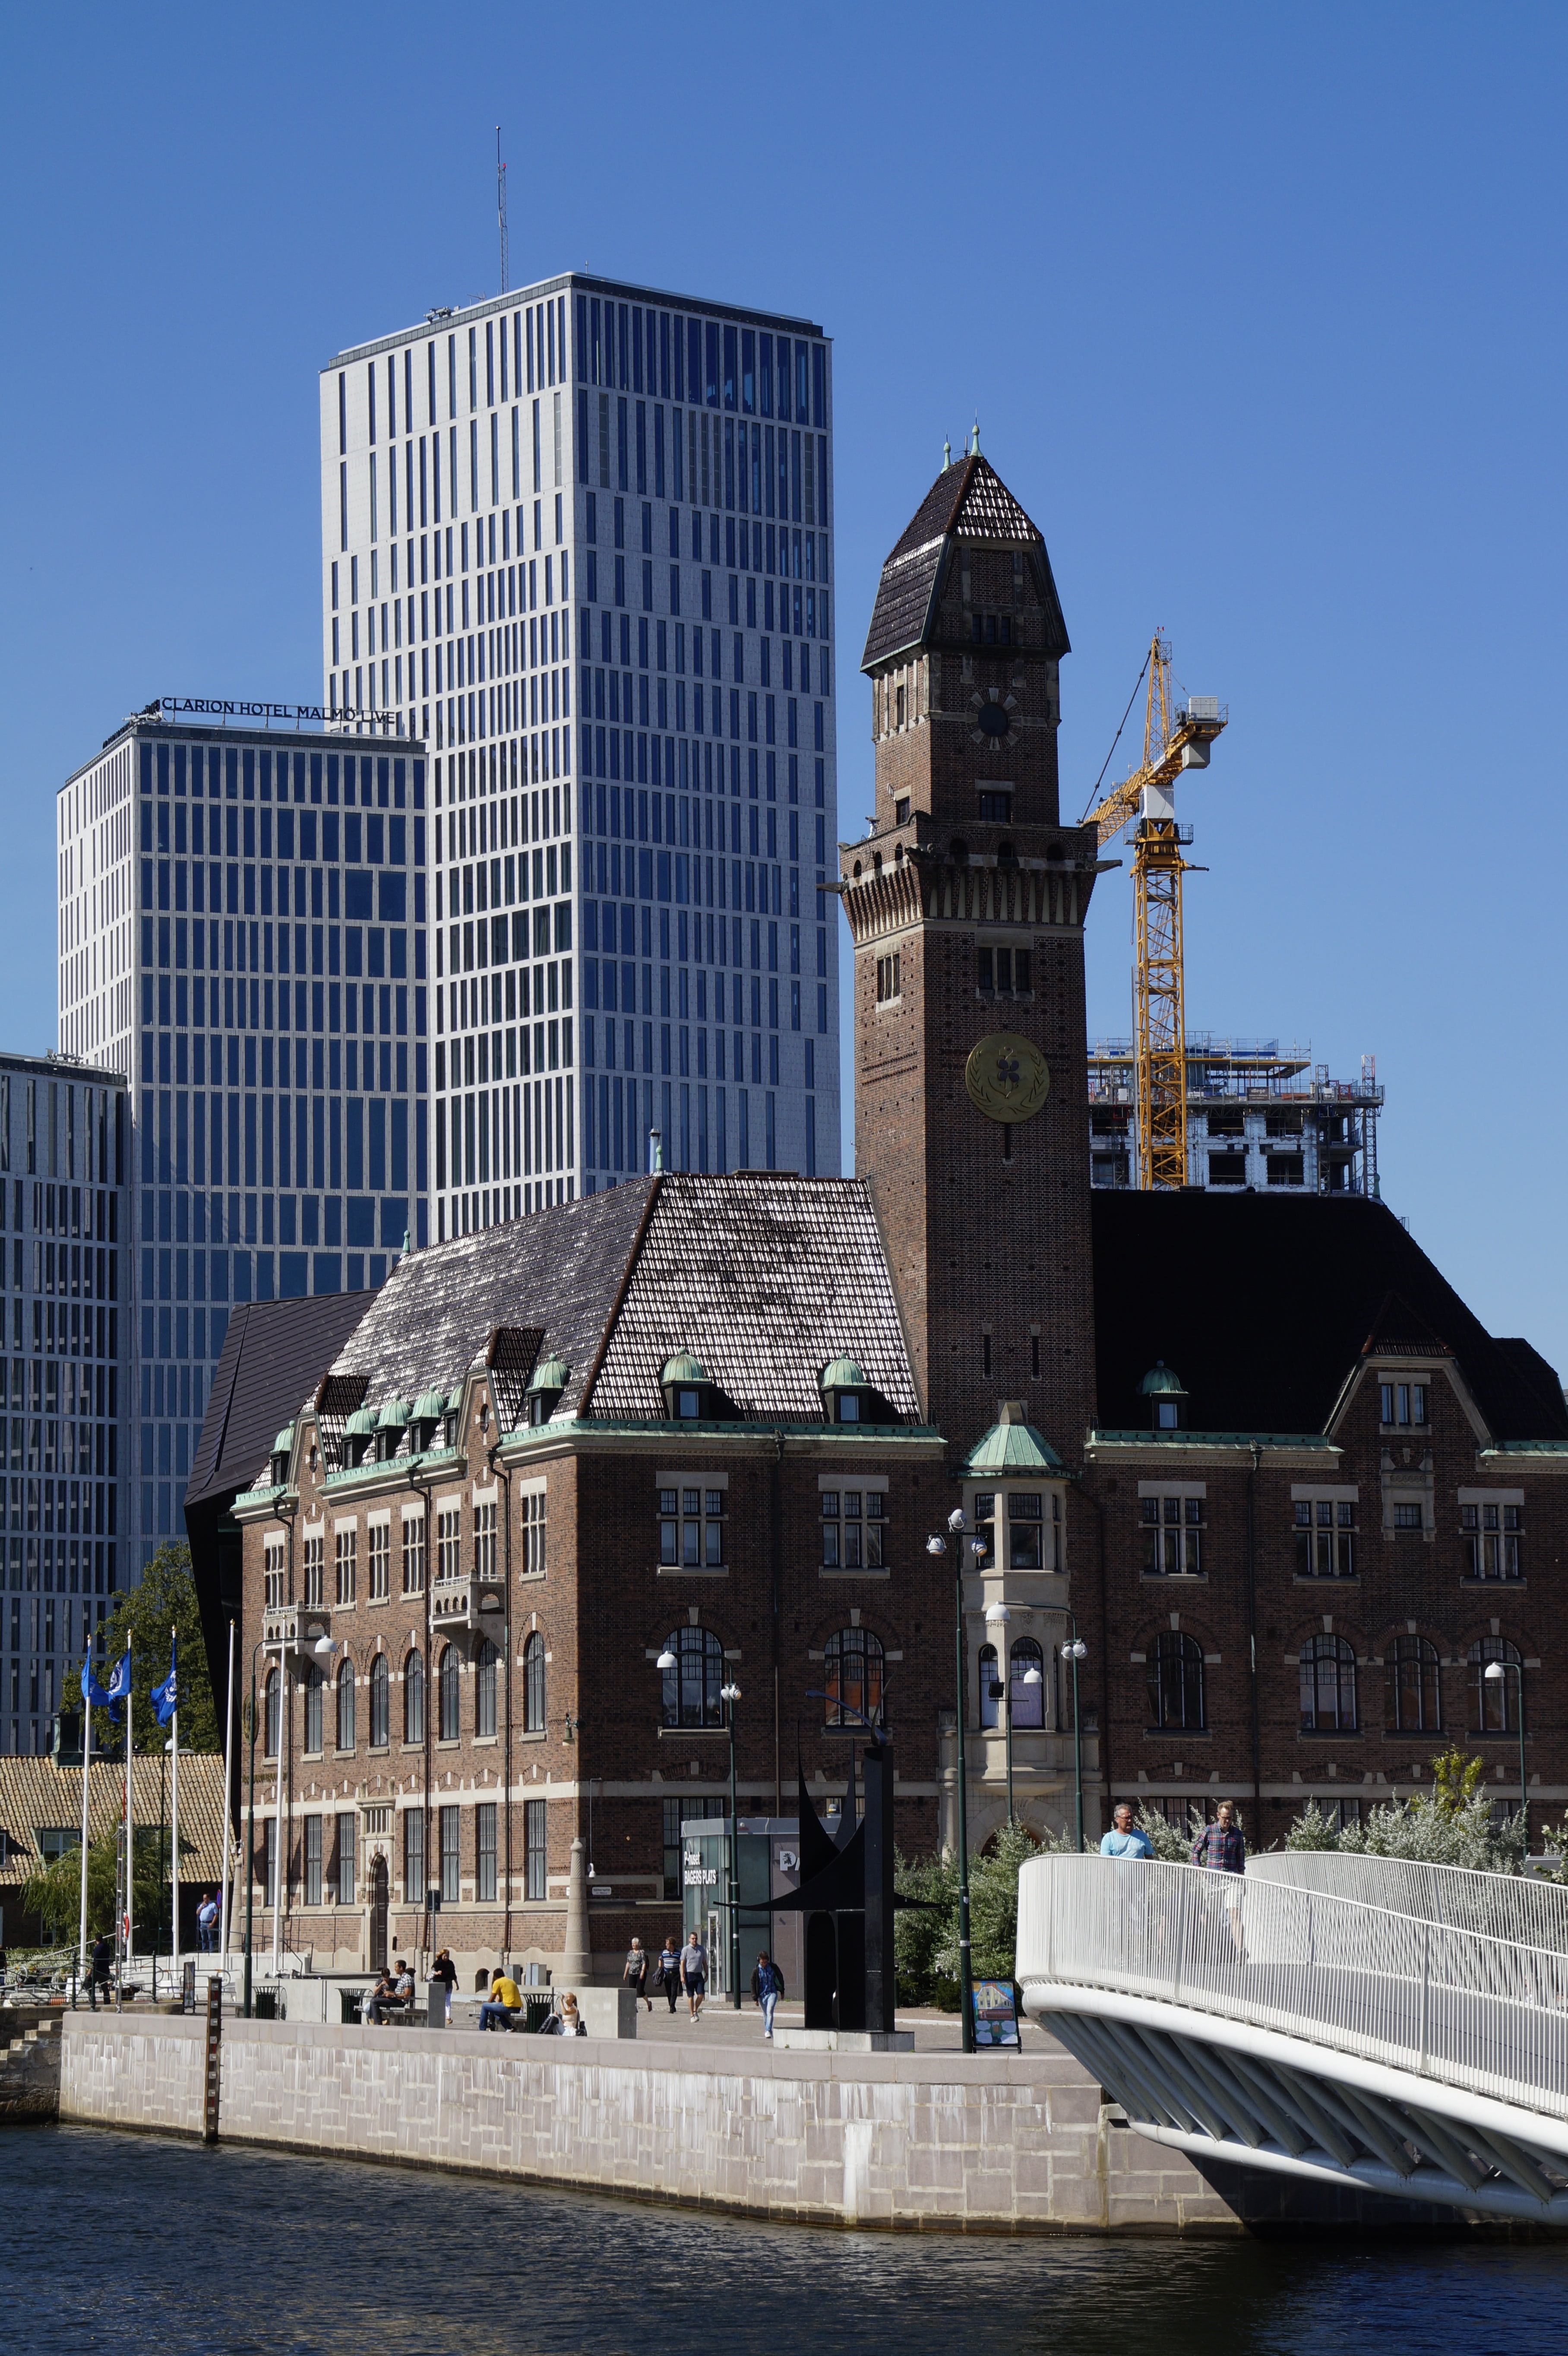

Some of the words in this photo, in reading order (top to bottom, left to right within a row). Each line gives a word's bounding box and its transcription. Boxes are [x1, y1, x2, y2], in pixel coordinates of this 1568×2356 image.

[162, 697, 234, 713] CLARION
[240, 703, 292, 717] HOTEL
[298, 706, 355, 721] MALMÖ
[362, 711, 395, 724] LIVE
[684, 1851, 700, 1865] P-huset
[684, 1870, 702, 1885] BAGERS
[702, 1869, 716, 1884] PLATS
